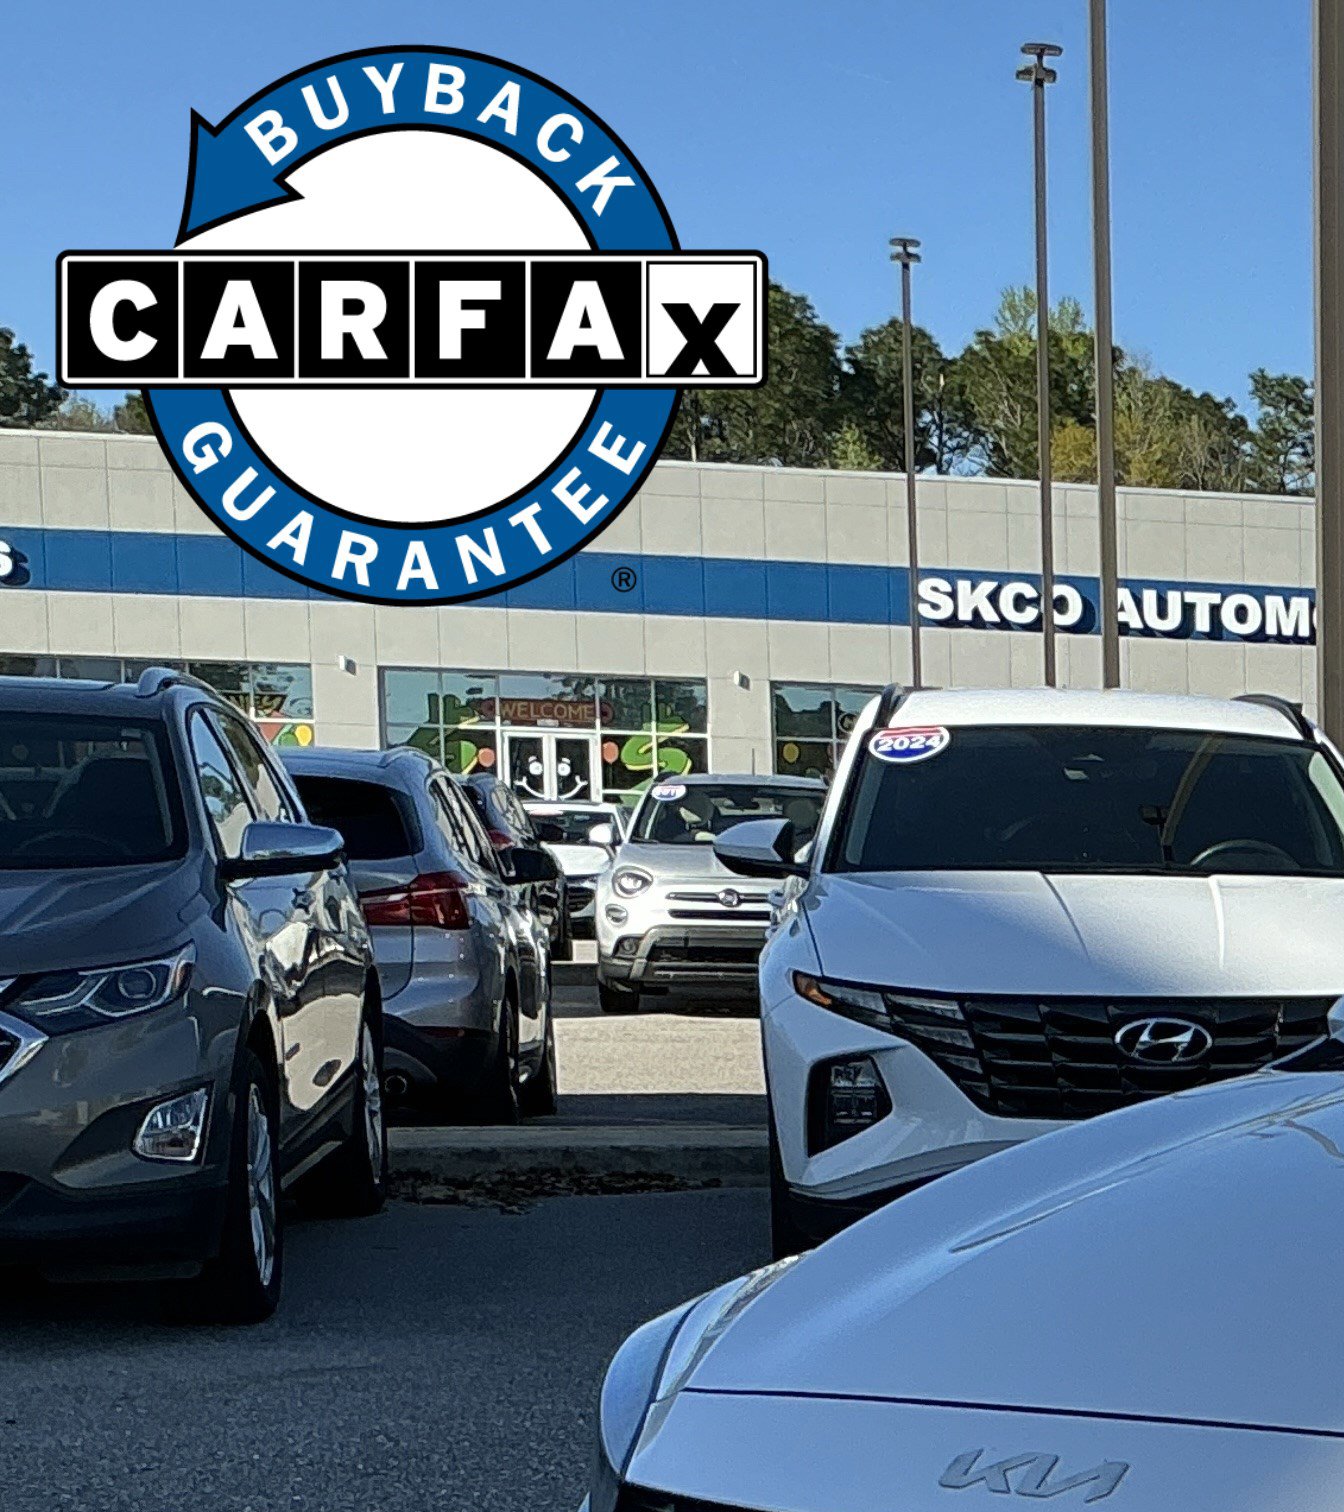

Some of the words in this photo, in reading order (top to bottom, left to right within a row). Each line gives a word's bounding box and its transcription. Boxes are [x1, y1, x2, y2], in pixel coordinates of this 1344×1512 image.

[916, 576, 1084, 626] SKCO
[501, 700, 596, 721] WELCOME
[876, 735, 942, 752] 2024
